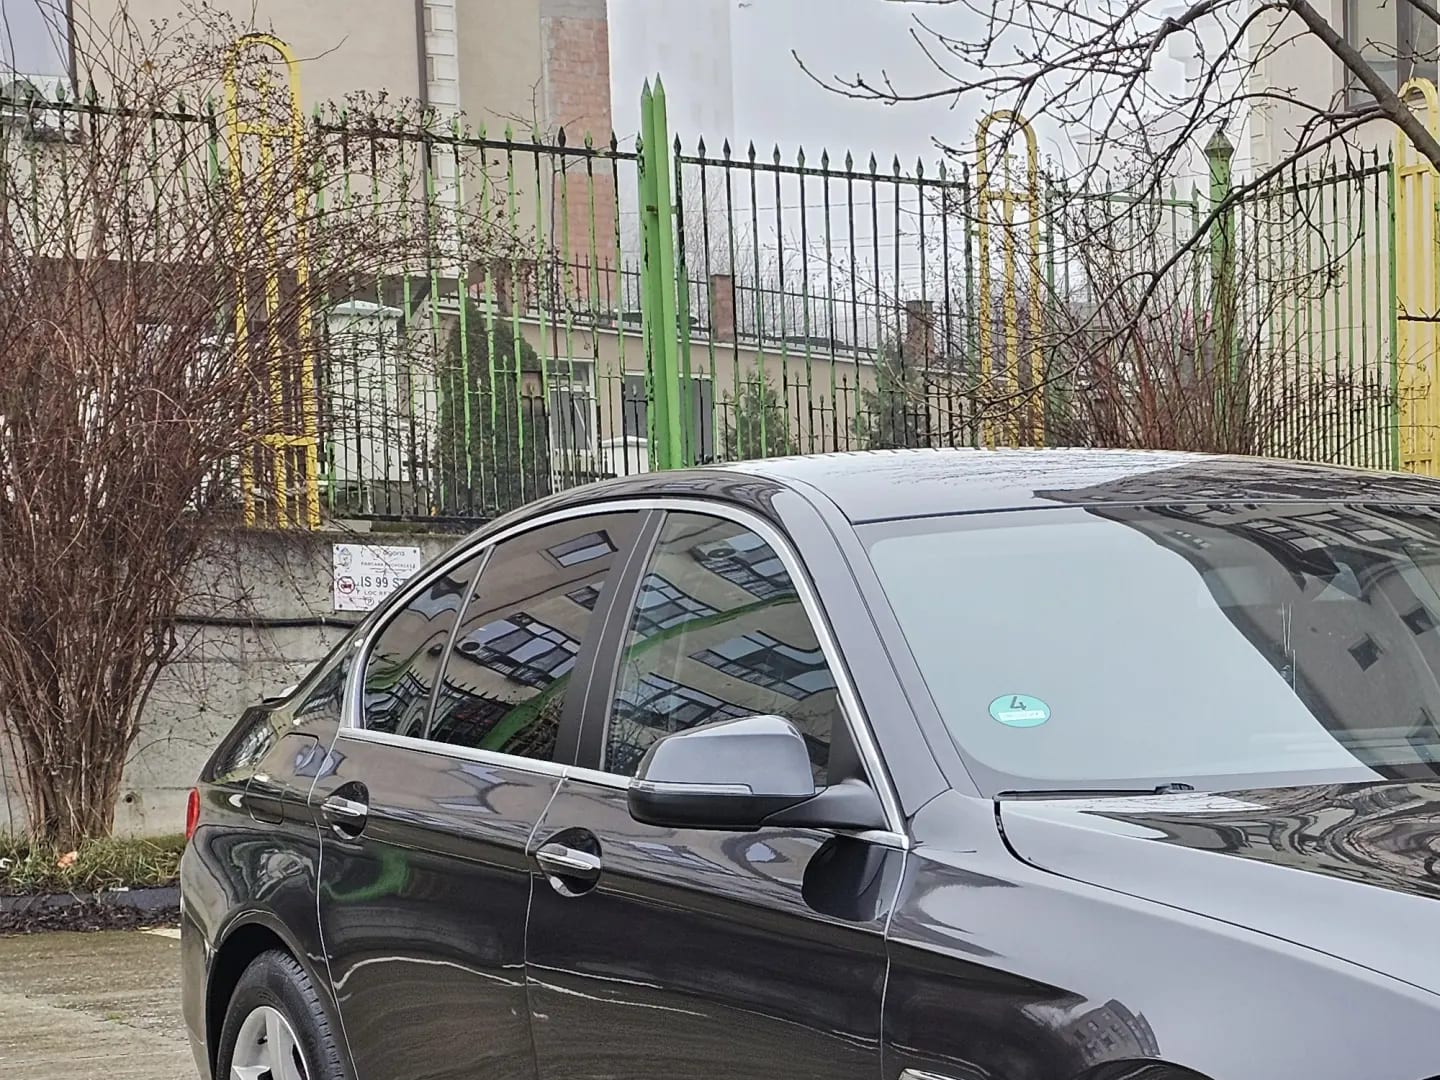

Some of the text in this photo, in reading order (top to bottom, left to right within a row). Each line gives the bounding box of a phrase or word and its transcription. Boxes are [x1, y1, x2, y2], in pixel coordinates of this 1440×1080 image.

[360, 576, 372, 588] IS
[375, 576, 389, 588] 99
[1010, 695, 1027, 711] 4
